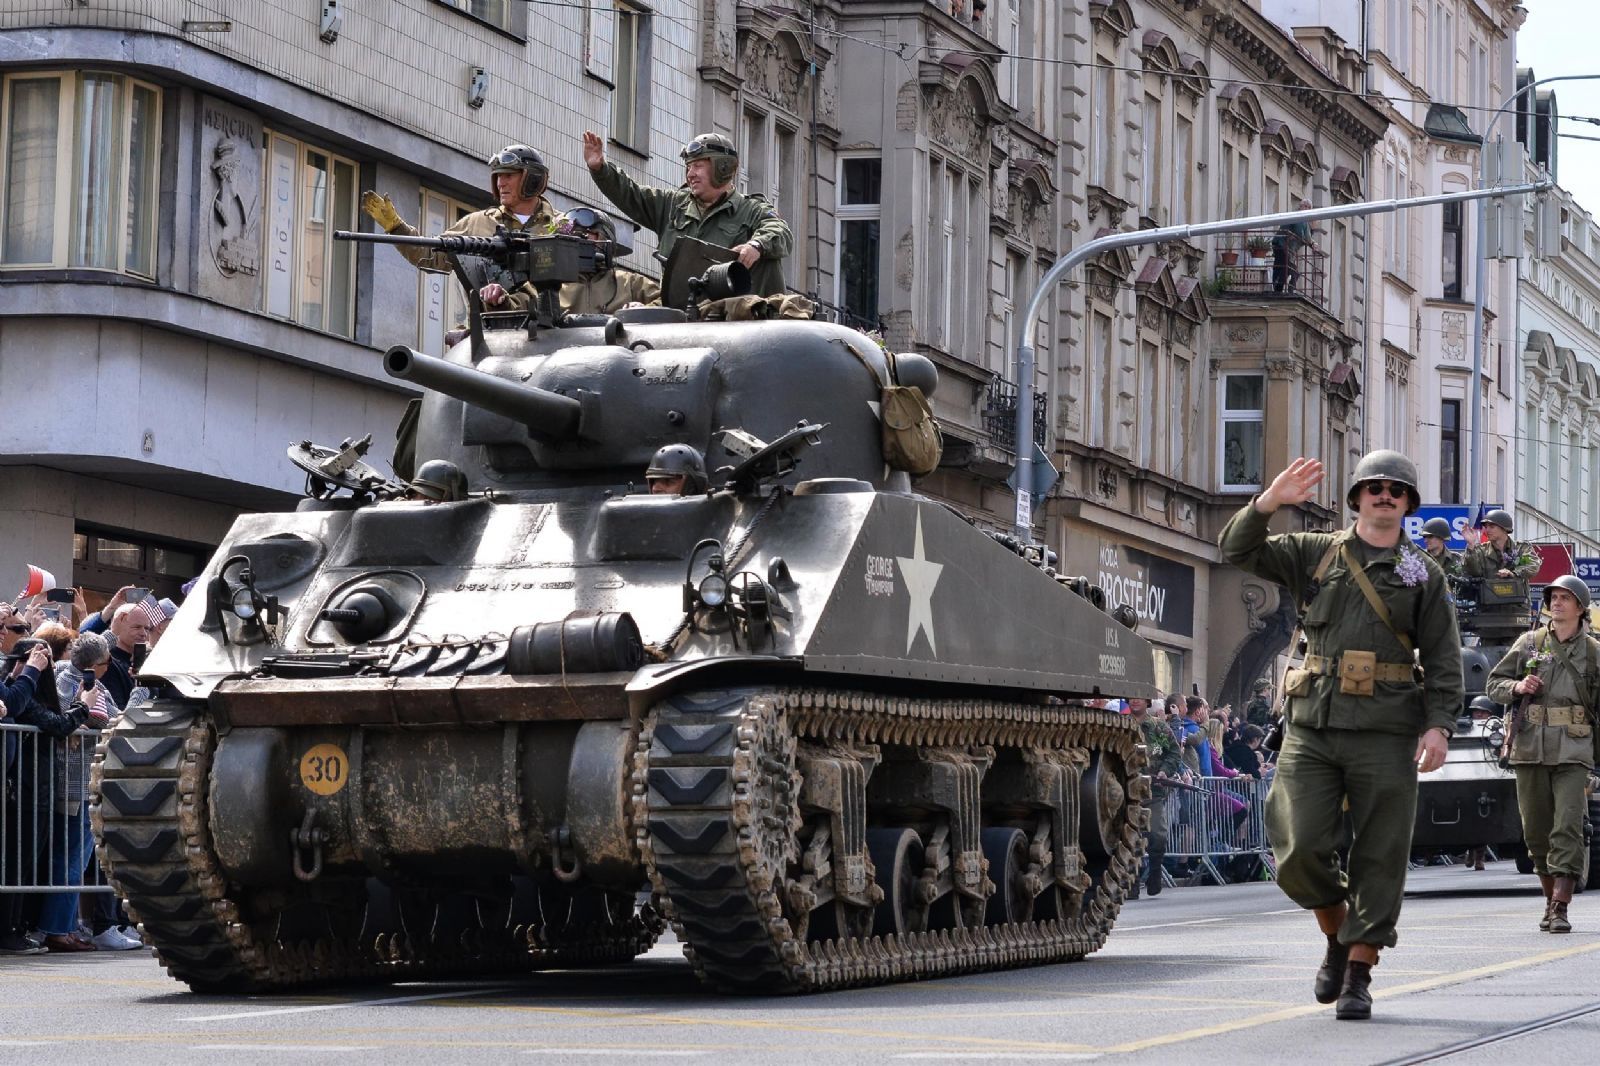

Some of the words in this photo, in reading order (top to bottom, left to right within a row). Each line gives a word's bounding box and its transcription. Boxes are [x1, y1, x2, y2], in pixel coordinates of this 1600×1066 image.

[204, 108, 255, 149] MERCUR
[1404, 516, 1470, 541] BS
[866, 554, 893, 578] GEORGE
[308, 756, 341, 782] 30
